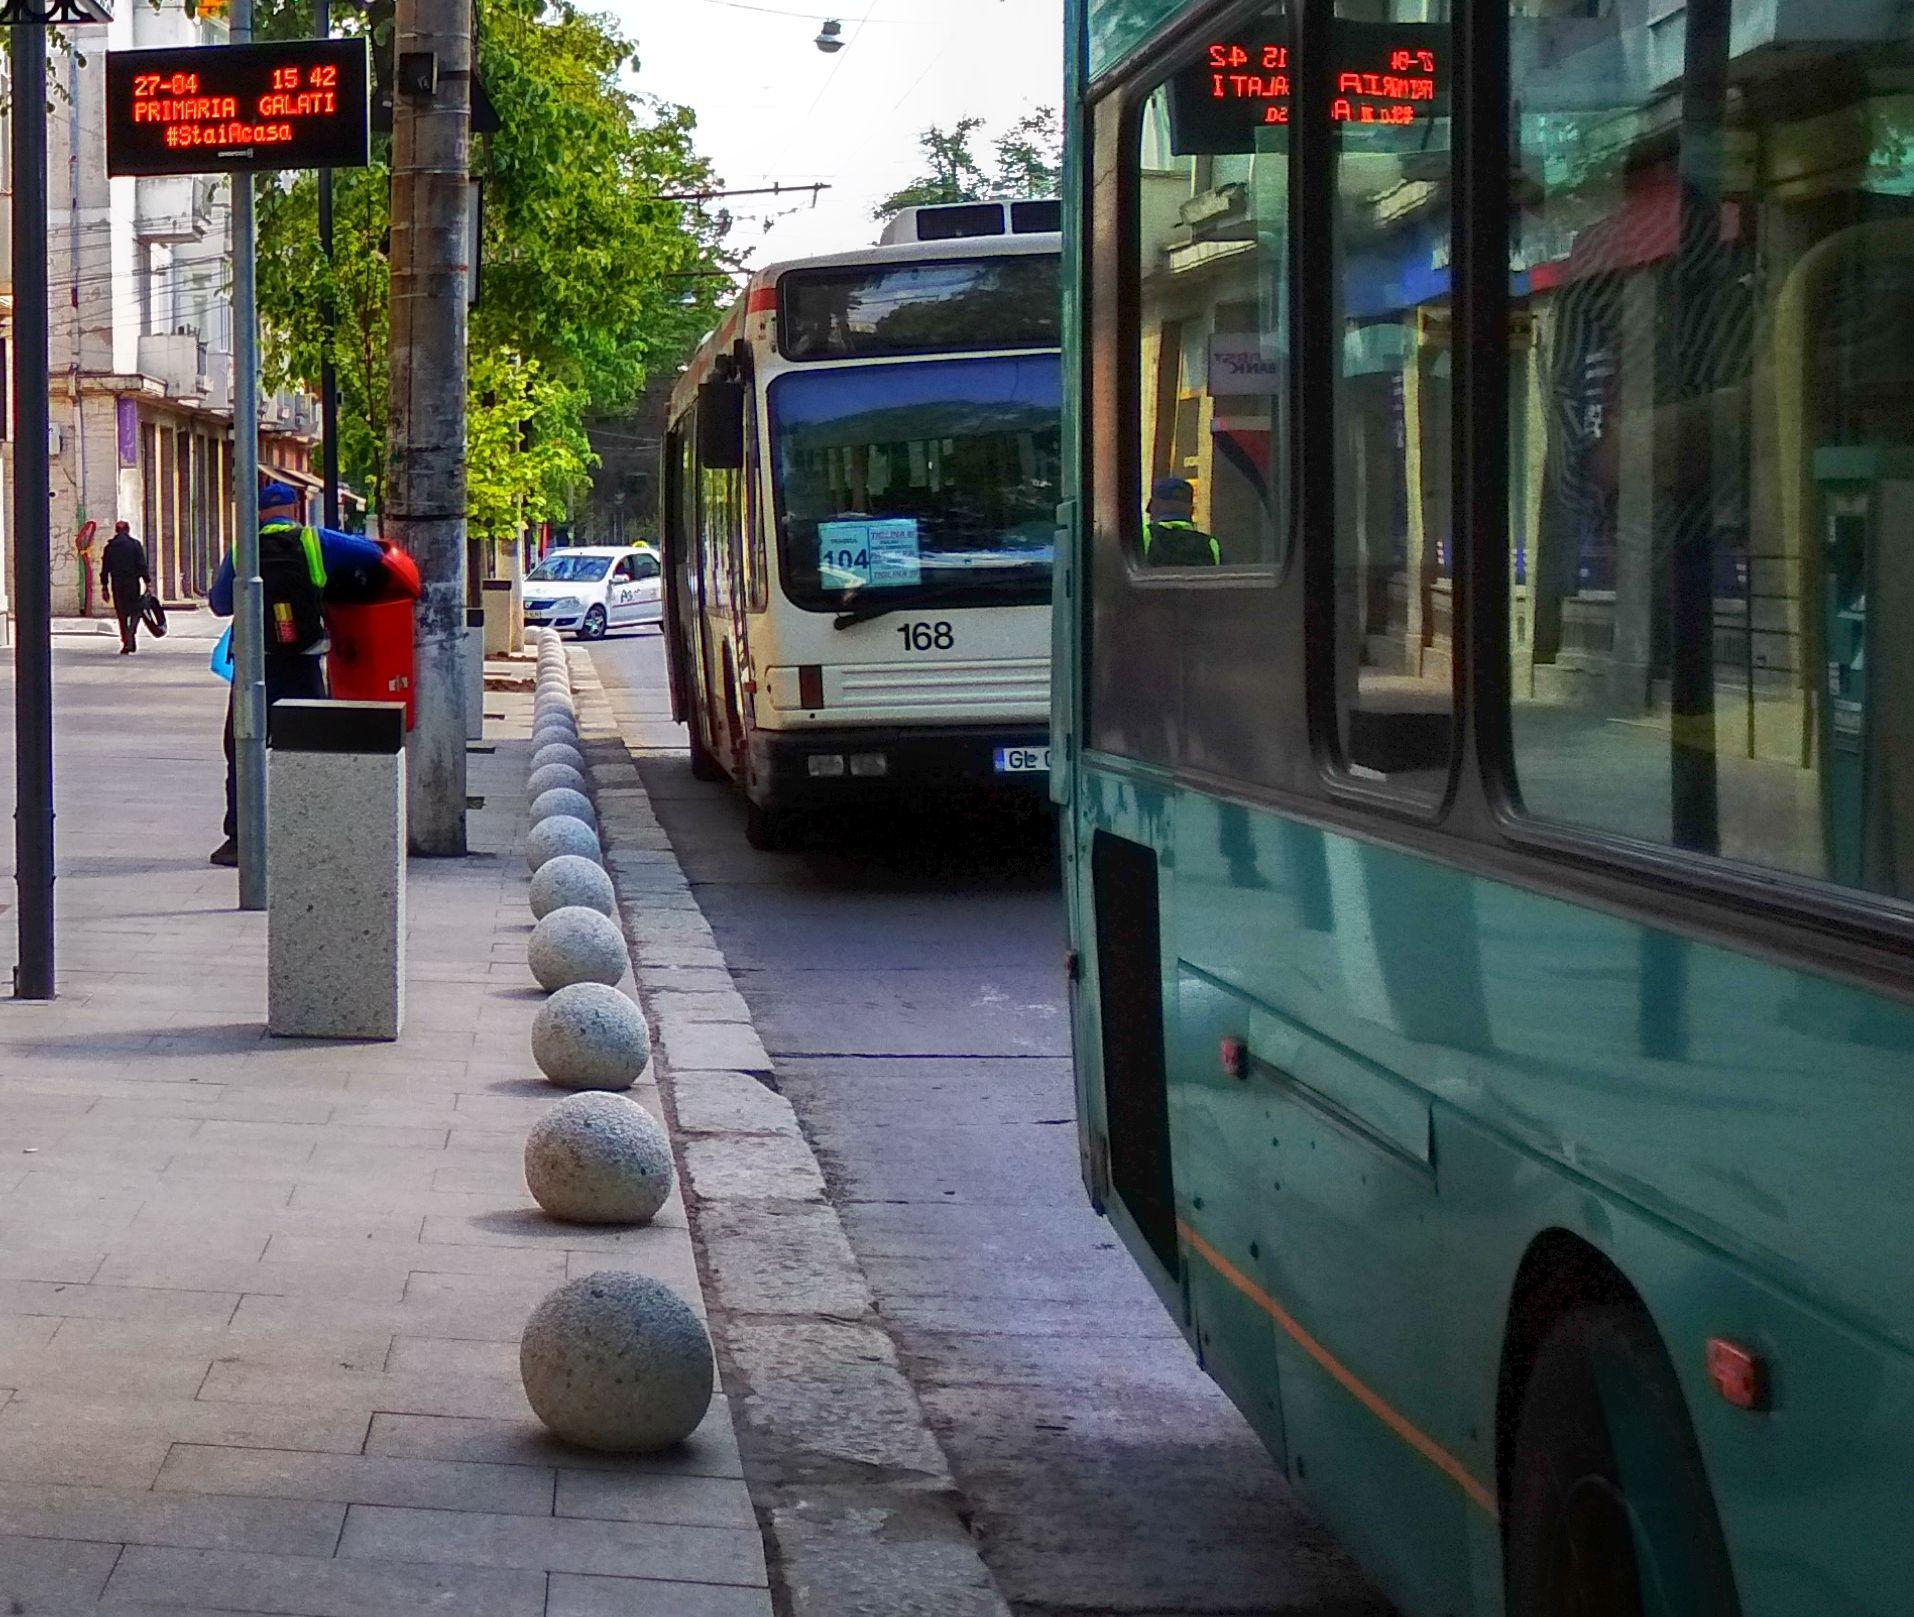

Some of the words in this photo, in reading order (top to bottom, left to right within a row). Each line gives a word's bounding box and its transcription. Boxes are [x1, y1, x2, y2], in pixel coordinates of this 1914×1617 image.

[134, 73, 198, 96] 27-04
[272, 67, 298, 90] 15
[310, 66, 336, 88] 42
[134, 97, 236, 122] PRIMARIA
[259, 93, 335, 117] GALATI
[166, 122, 292, 147] #StaiAcasa
[823, 548, 870, 570] 104
[897, 621, 954, 651] 168
